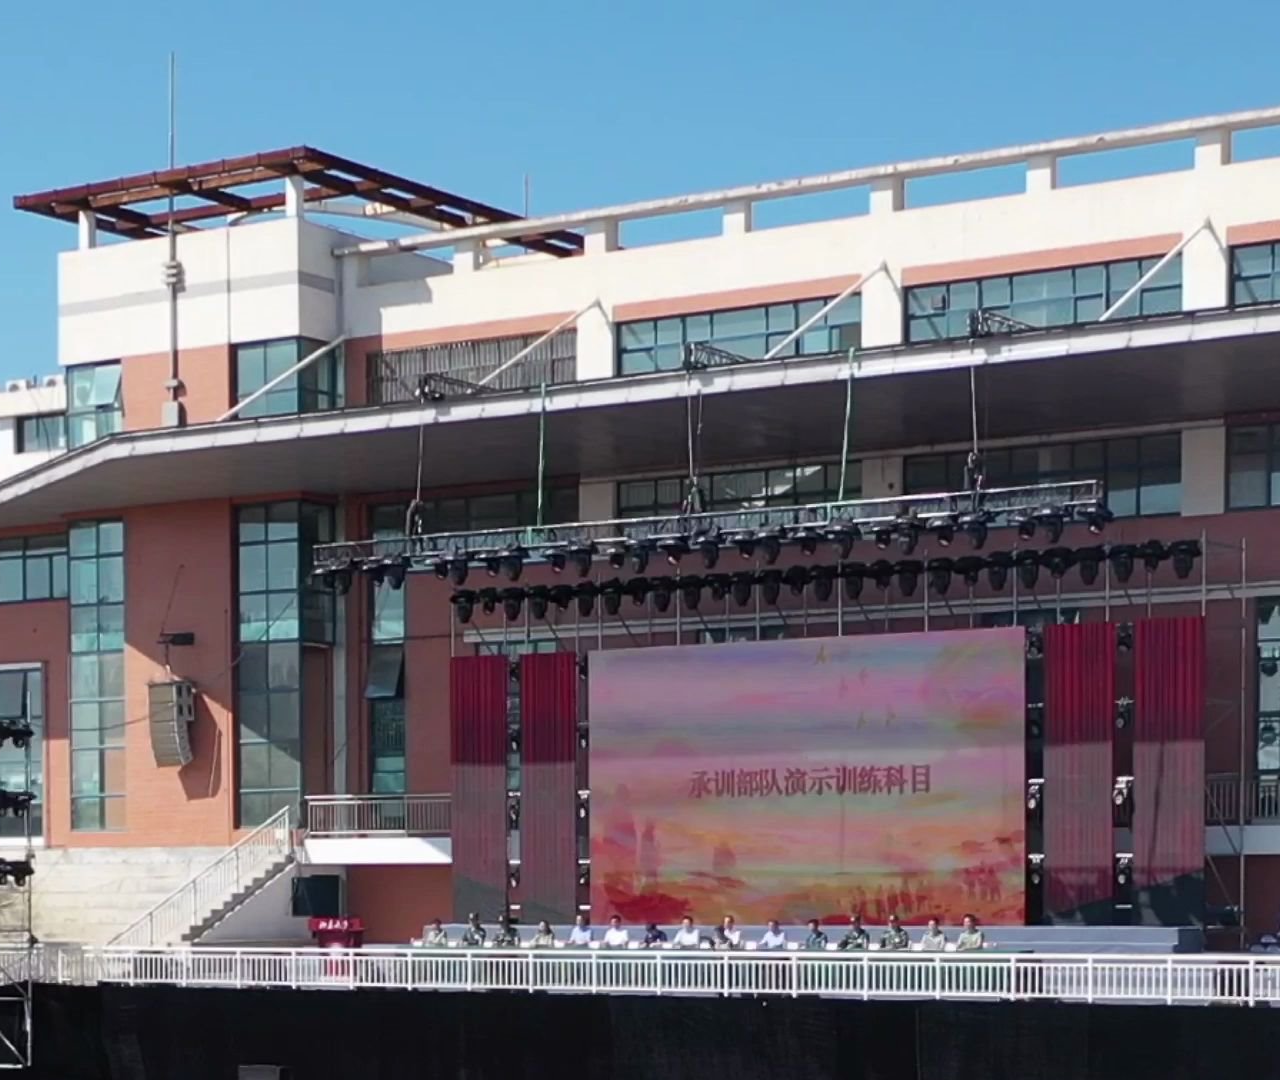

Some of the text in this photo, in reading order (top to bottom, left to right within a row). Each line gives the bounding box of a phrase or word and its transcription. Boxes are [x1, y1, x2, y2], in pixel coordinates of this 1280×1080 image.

[688, 763, 932, 799] 承训部队演示训练科目
